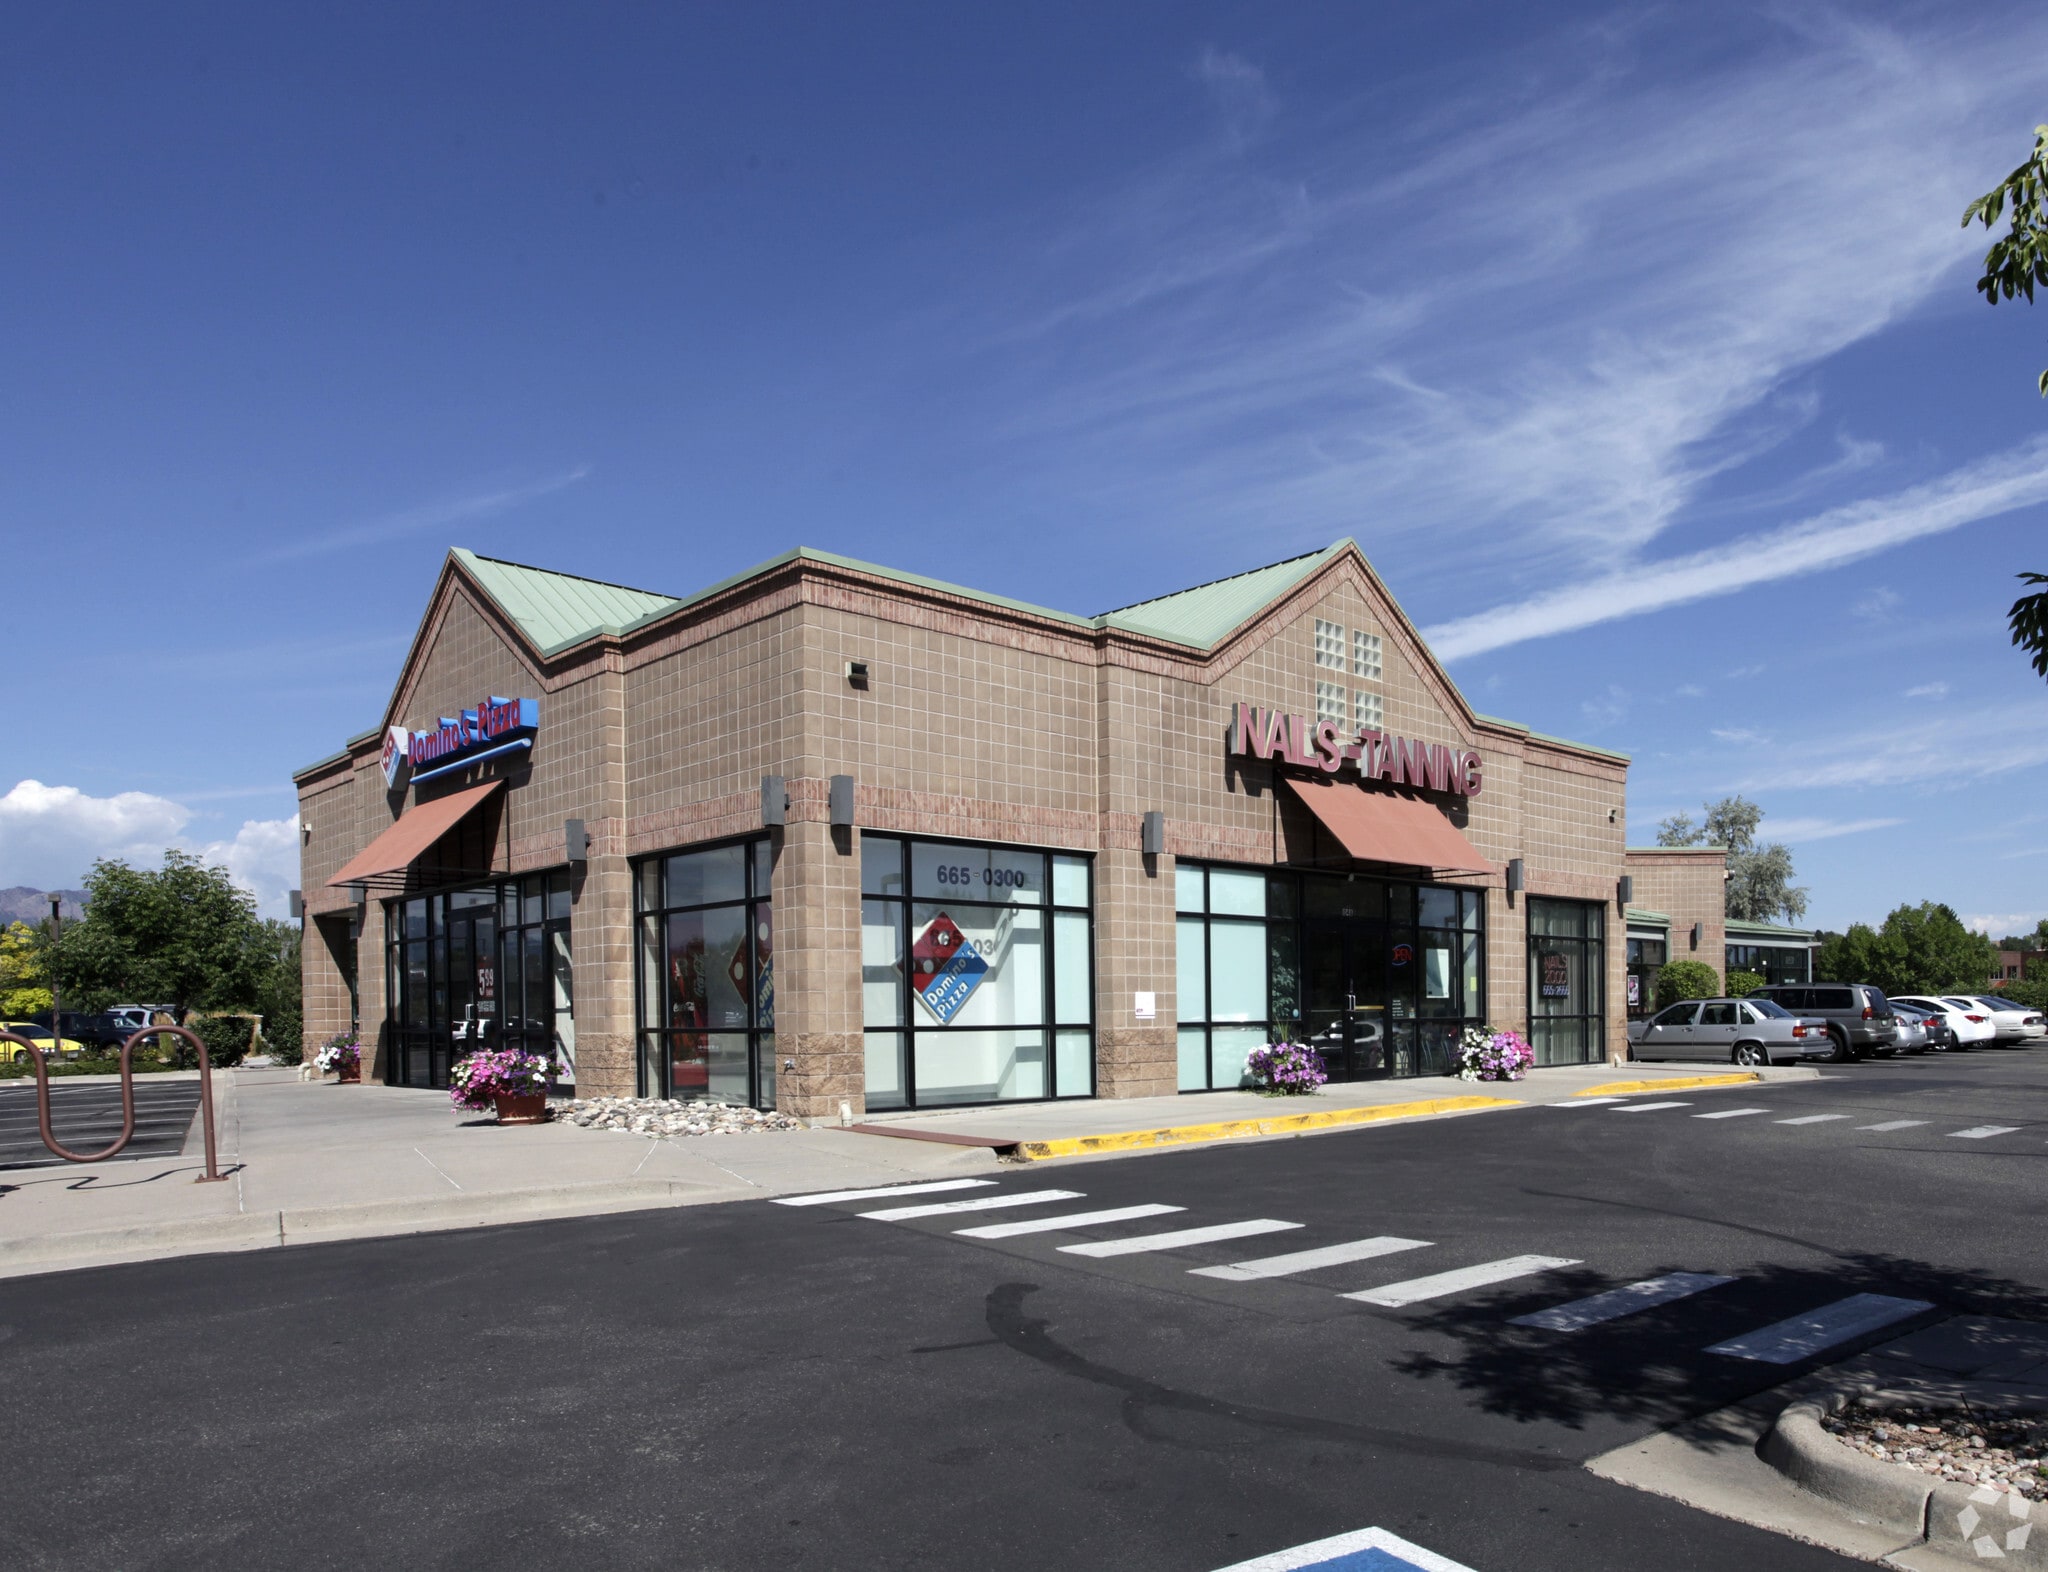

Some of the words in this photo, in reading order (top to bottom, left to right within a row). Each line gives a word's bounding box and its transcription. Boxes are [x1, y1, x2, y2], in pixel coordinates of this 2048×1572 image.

[407, 711, 471, 767] Domino's
[477, 696, 520, 742] Pizza
[926, 947, 976, 1006] Domino's
[1543, 953, 1568, 970] NAILS
[936, 981, 969, 1018] Pizza
